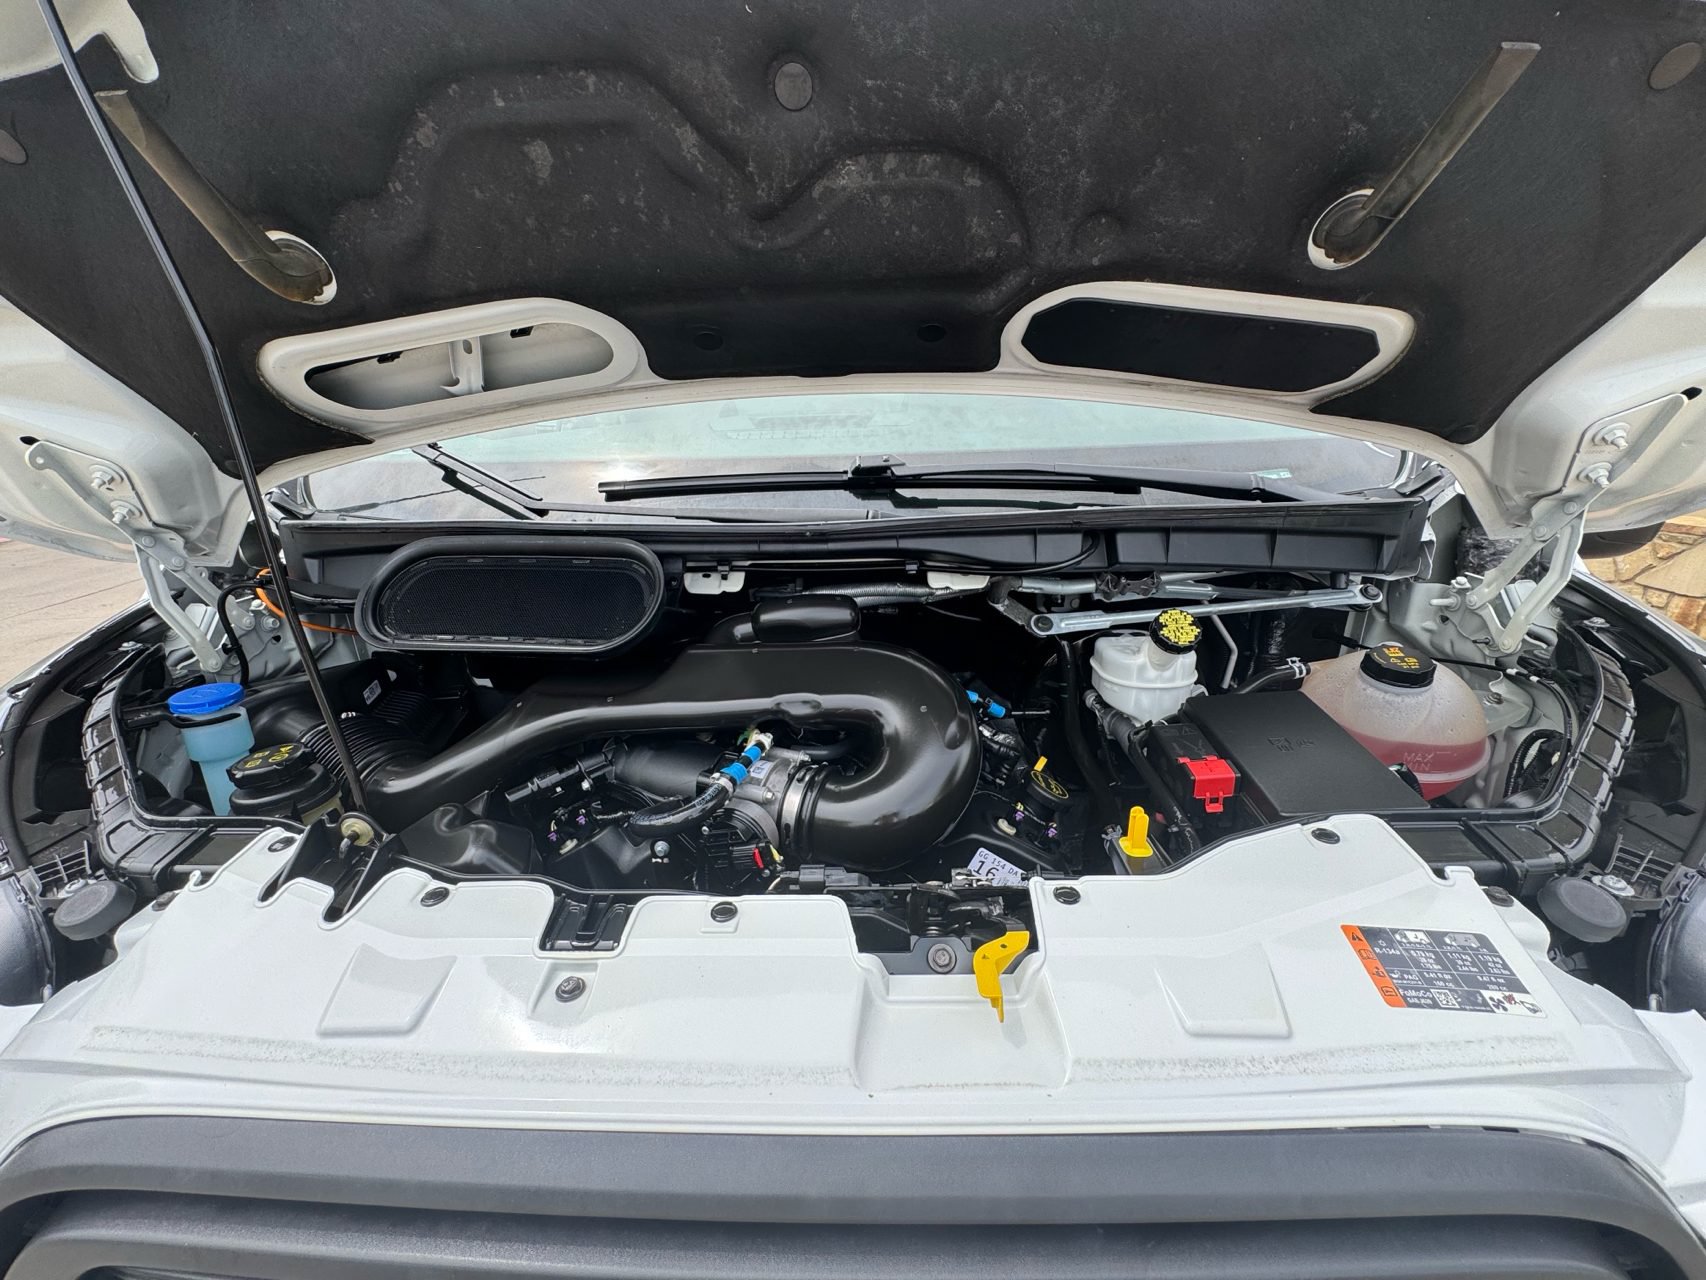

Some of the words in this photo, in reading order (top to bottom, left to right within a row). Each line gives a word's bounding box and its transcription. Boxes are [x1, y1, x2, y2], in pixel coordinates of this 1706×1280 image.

[1403, 752, 1434, 763] MAX
[978, 850, 990, 860] GG
[991, 857, 1007, 870] 154
[1007, 867, 1019, 877] DA
[1399, 989, 1433, 998] FoMoCo
